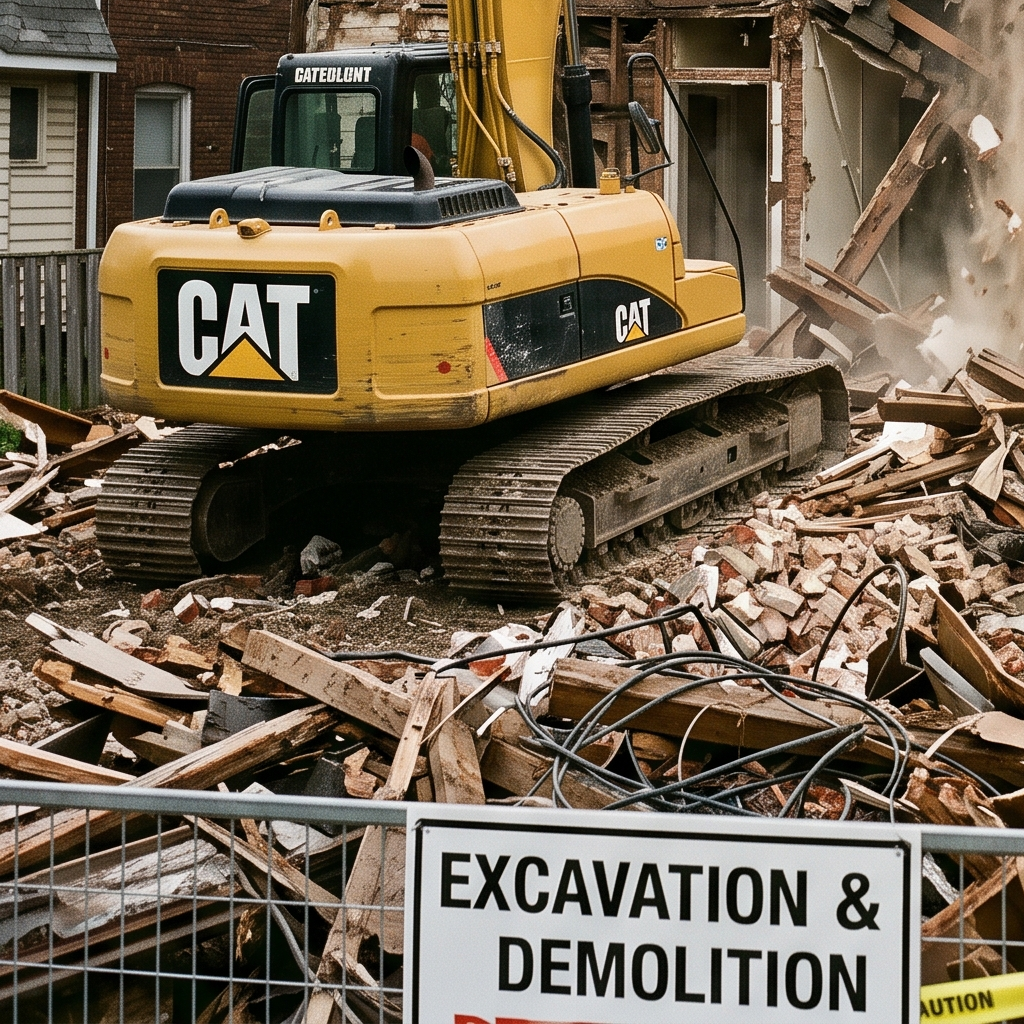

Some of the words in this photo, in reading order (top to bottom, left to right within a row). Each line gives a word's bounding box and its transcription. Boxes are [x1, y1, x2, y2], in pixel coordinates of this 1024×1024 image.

[178, 279, 310, 382] CAT
[615, 297, 651, 344] CAT
[440, 852, 808, 927] EXCAVATION
[836, 872, 881, 931] &
[499, 936, 868, 1013] DEMOLITION
[920, 989, 995, 1018] AUTION
